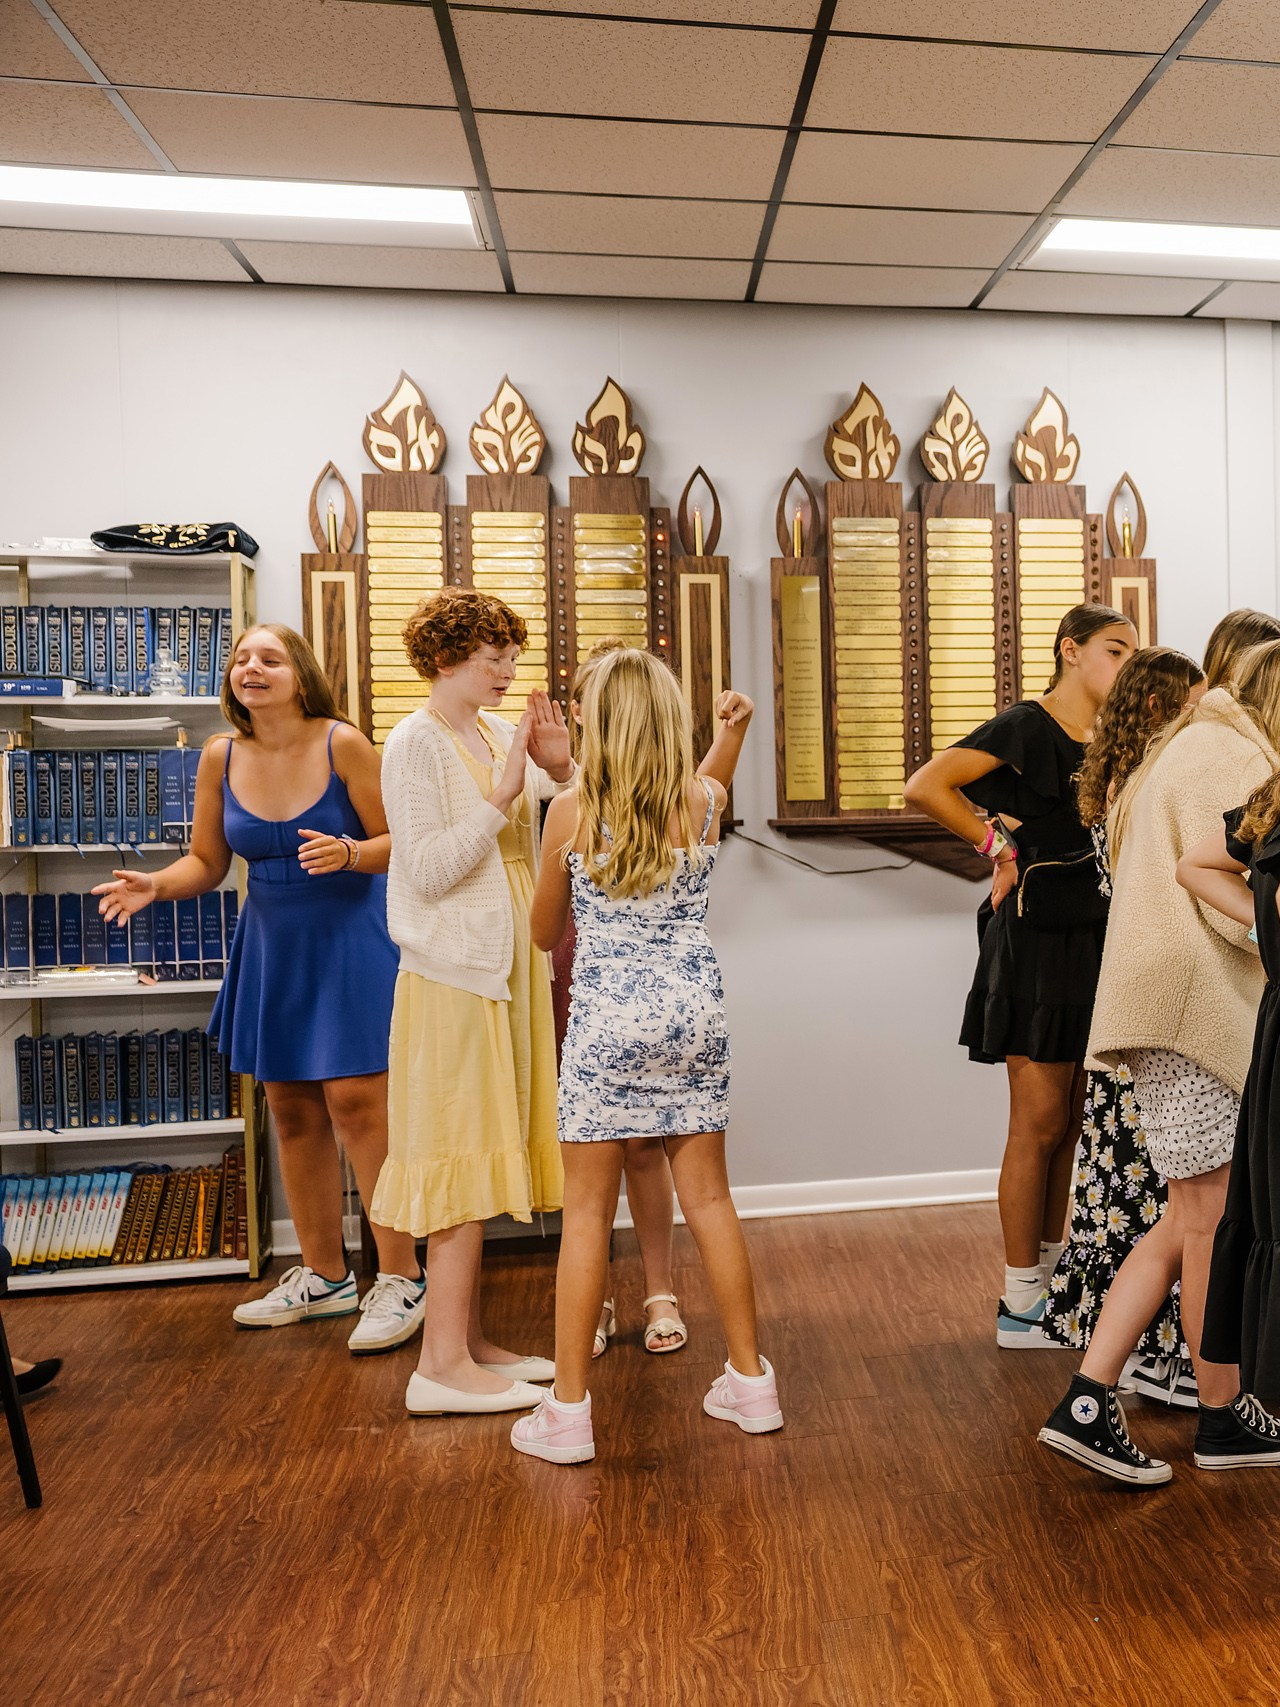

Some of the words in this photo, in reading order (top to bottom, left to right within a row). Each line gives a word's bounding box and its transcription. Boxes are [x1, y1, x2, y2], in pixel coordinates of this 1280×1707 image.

[5, 624, 17, 671] SIDDUR
[27, 624, 39, 671] SIDDUR
[49, 626, 61, 671] SIDDUR
[72, 626, 84, 671] SIDDUR
[94, 626, 106, 671] SIDDUR
[116, 626, 127, 671] SIDDUR
[136, 626, 147, 671] SIDDUR
[179, 626, 190, 671] SIDDUR
[199, 626, 210, 671] SIDDUR
[14, 771, 27, 818] SIDDUR
[38, 771, 50, 818] SIDDUR
[60, 770, 72, 818] SIDDUR
[83, 771, 94, 817] SIDDUR
[105, 770, 117, 817] SIDDUR
[127, 770, 139, 817] SIDDUR
[147, 768, 158, 815] SIDDUR
[67, 1057, 79, 1101] SIDDUR
[88, 1055, 100, 1099] SIDDUR
[105, 1055, 117, 1100] SIDDUR
[128, 1051, 140, 1097] SIDDUR
[147, 1051, 158, 1097] SIDDUR
[168, 1051, 179, 1097] SIDDUR
[190, 1050, 200, 1096] SIDDUR
